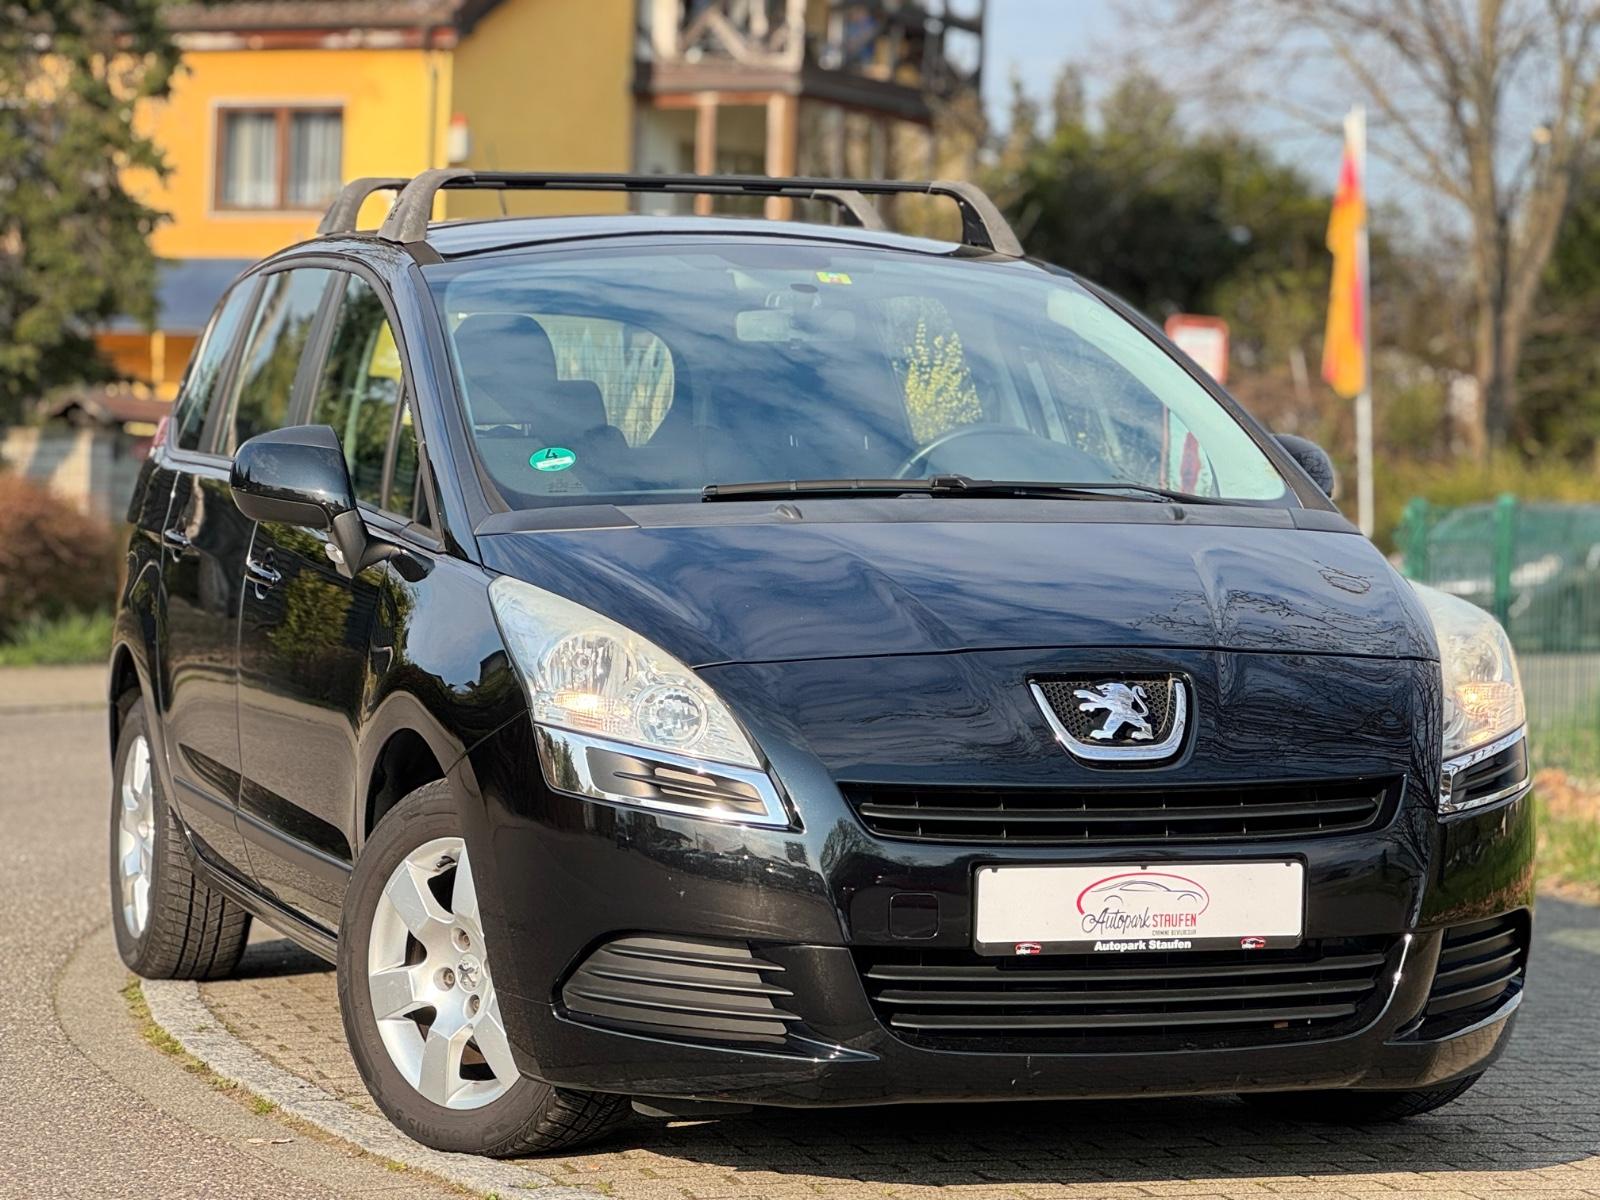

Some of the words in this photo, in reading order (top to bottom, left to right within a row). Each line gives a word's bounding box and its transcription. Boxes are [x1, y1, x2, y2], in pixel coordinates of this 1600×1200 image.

[545, 448, 558, 459] 4
[1082, 907, 1151, 935] Autopark
[1152, 913, 1197, 928] STAUFEN
[1094, 941, 1146, 952] Autopark
[1149, 939, 1192, 950] Staufen
